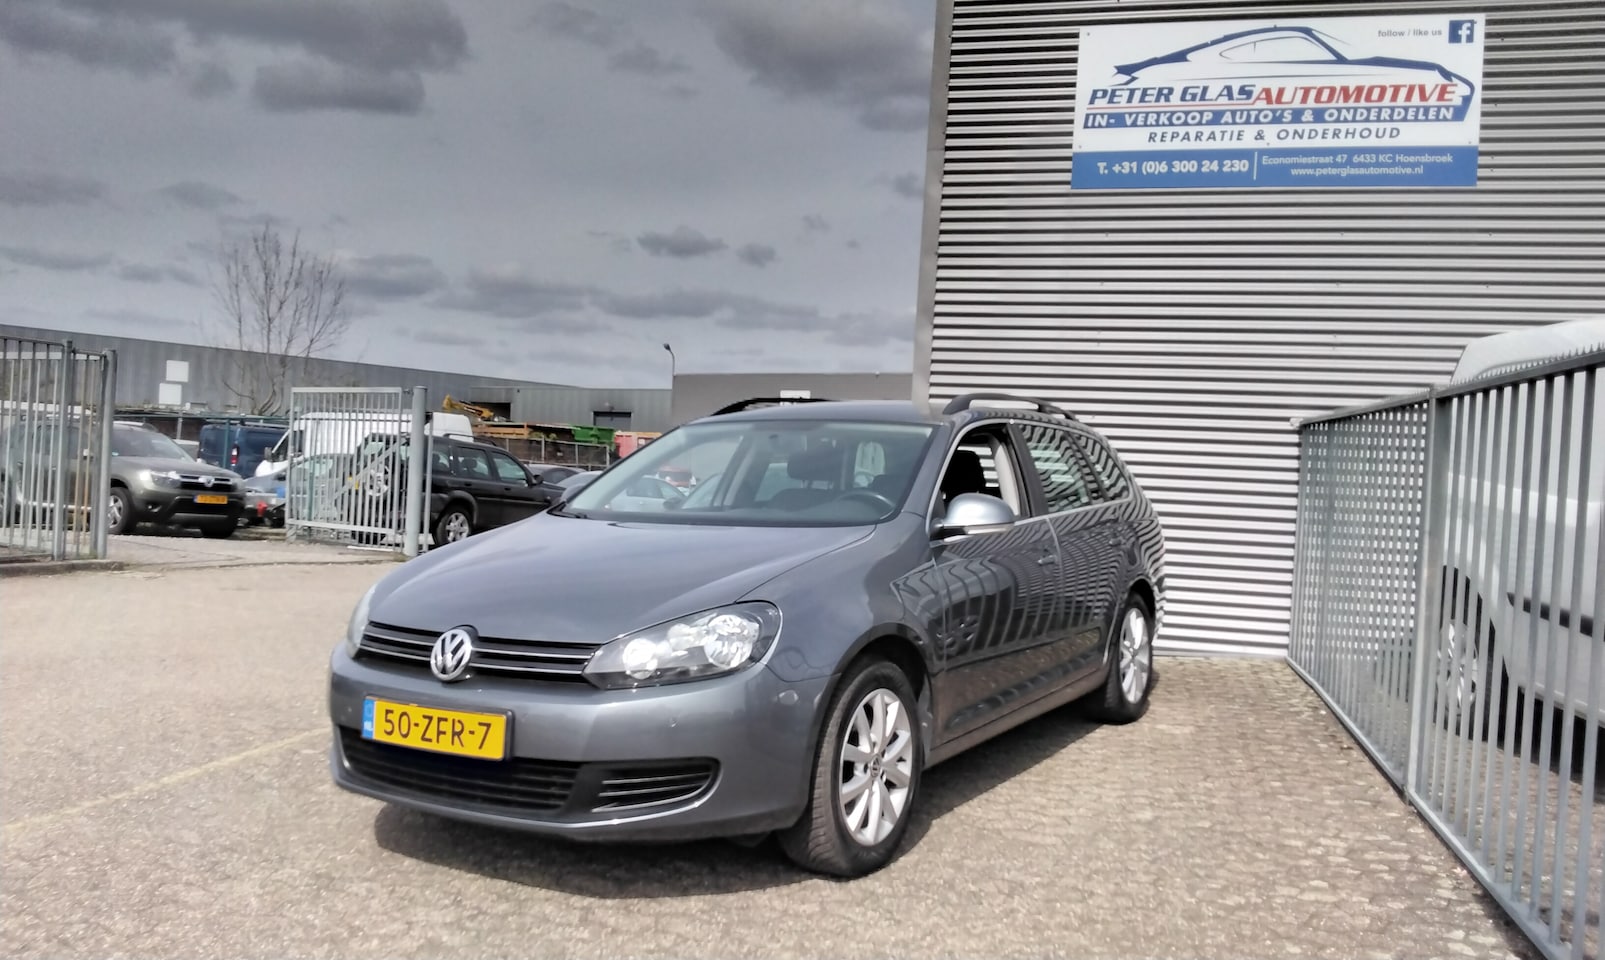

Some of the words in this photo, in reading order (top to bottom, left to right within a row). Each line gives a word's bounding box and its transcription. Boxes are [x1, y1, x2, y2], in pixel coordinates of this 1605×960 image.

[1378, 30, 1405, 38] follow
[1088, 86, 1175, 105] PETER
[1180, 84, 1256, 102] GLAS
[1252, 84, 1458, 105] AUTOMOTIVE
[1087, 114, 1116, 127] IN-
[1124, 112, 1214, 126] VERKOOP
[1220, 110, 1293, 124] AUTO'S
[1301, 110, 1314, 122] &
[1324, 107, 1454, 121] ONDERDELEN
[1148, 130, 1245, 143] REPARATIE
[1254, 129, 1265, 141] &
[1276, 127, 1400, 141] ONDERHOUD
[1262, 154, 1334, 165] Economiestraat
[1336, 154, 1347, 163] 47
[1352, 154, 1376, 163] 6433
[1378, 154, 1393, 163] KC
[1396, 153, 1453, 163] Hoensbroek
[1097, 162, 1109, 175] T.
[1112, 162, 1137, 174] +31
[1142, 160, 1168, 176] (0)6
[1172, 160, 1198, 173] 300
[1201, 160, 1219, 173] 24
[1222, 159, 1249, 172] 230
[1290, 166, 1424, 177] www.peterglasautomotive.nl
[383, 708, 492, 750] 50-ZFR-7
